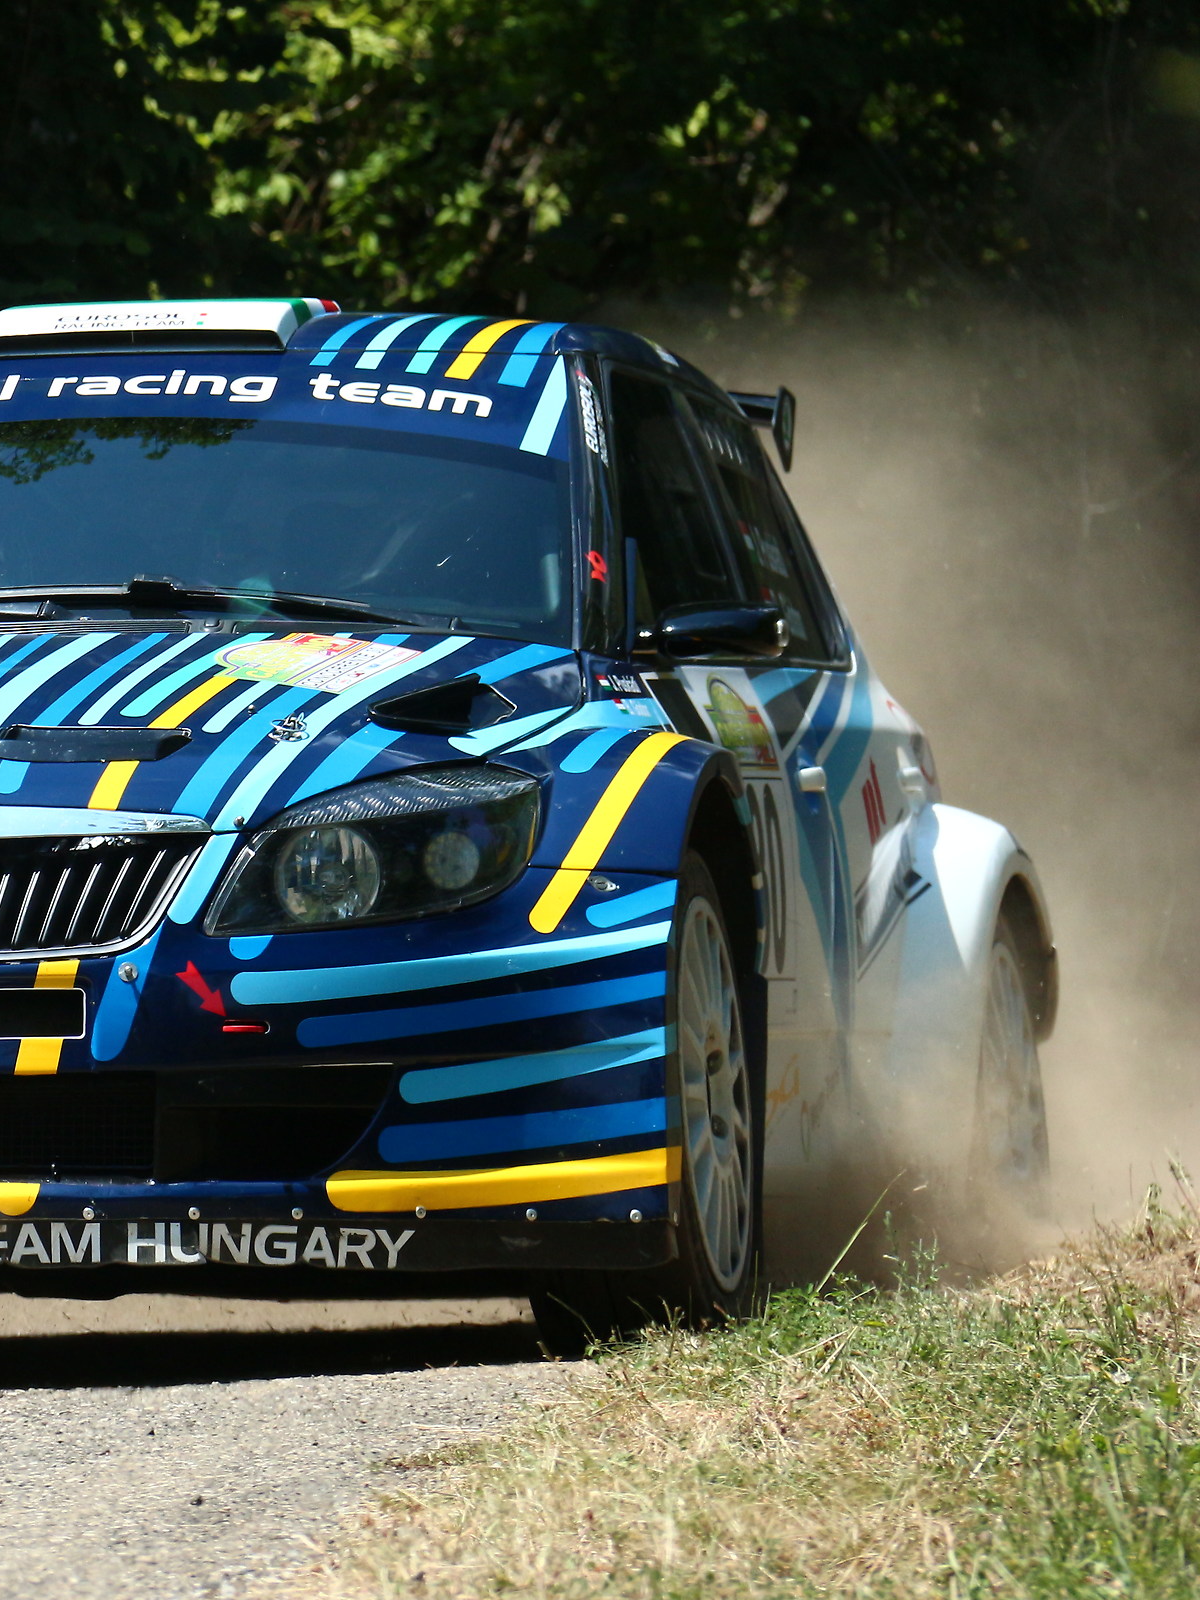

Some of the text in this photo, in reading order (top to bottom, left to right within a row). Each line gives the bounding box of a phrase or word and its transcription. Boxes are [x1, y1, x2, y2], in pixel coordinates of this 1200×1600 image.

[47, 369, 279, 402] racing
[308, 372, 493, 417] team
[126, 1220, 416, 1270] HUNGARY
